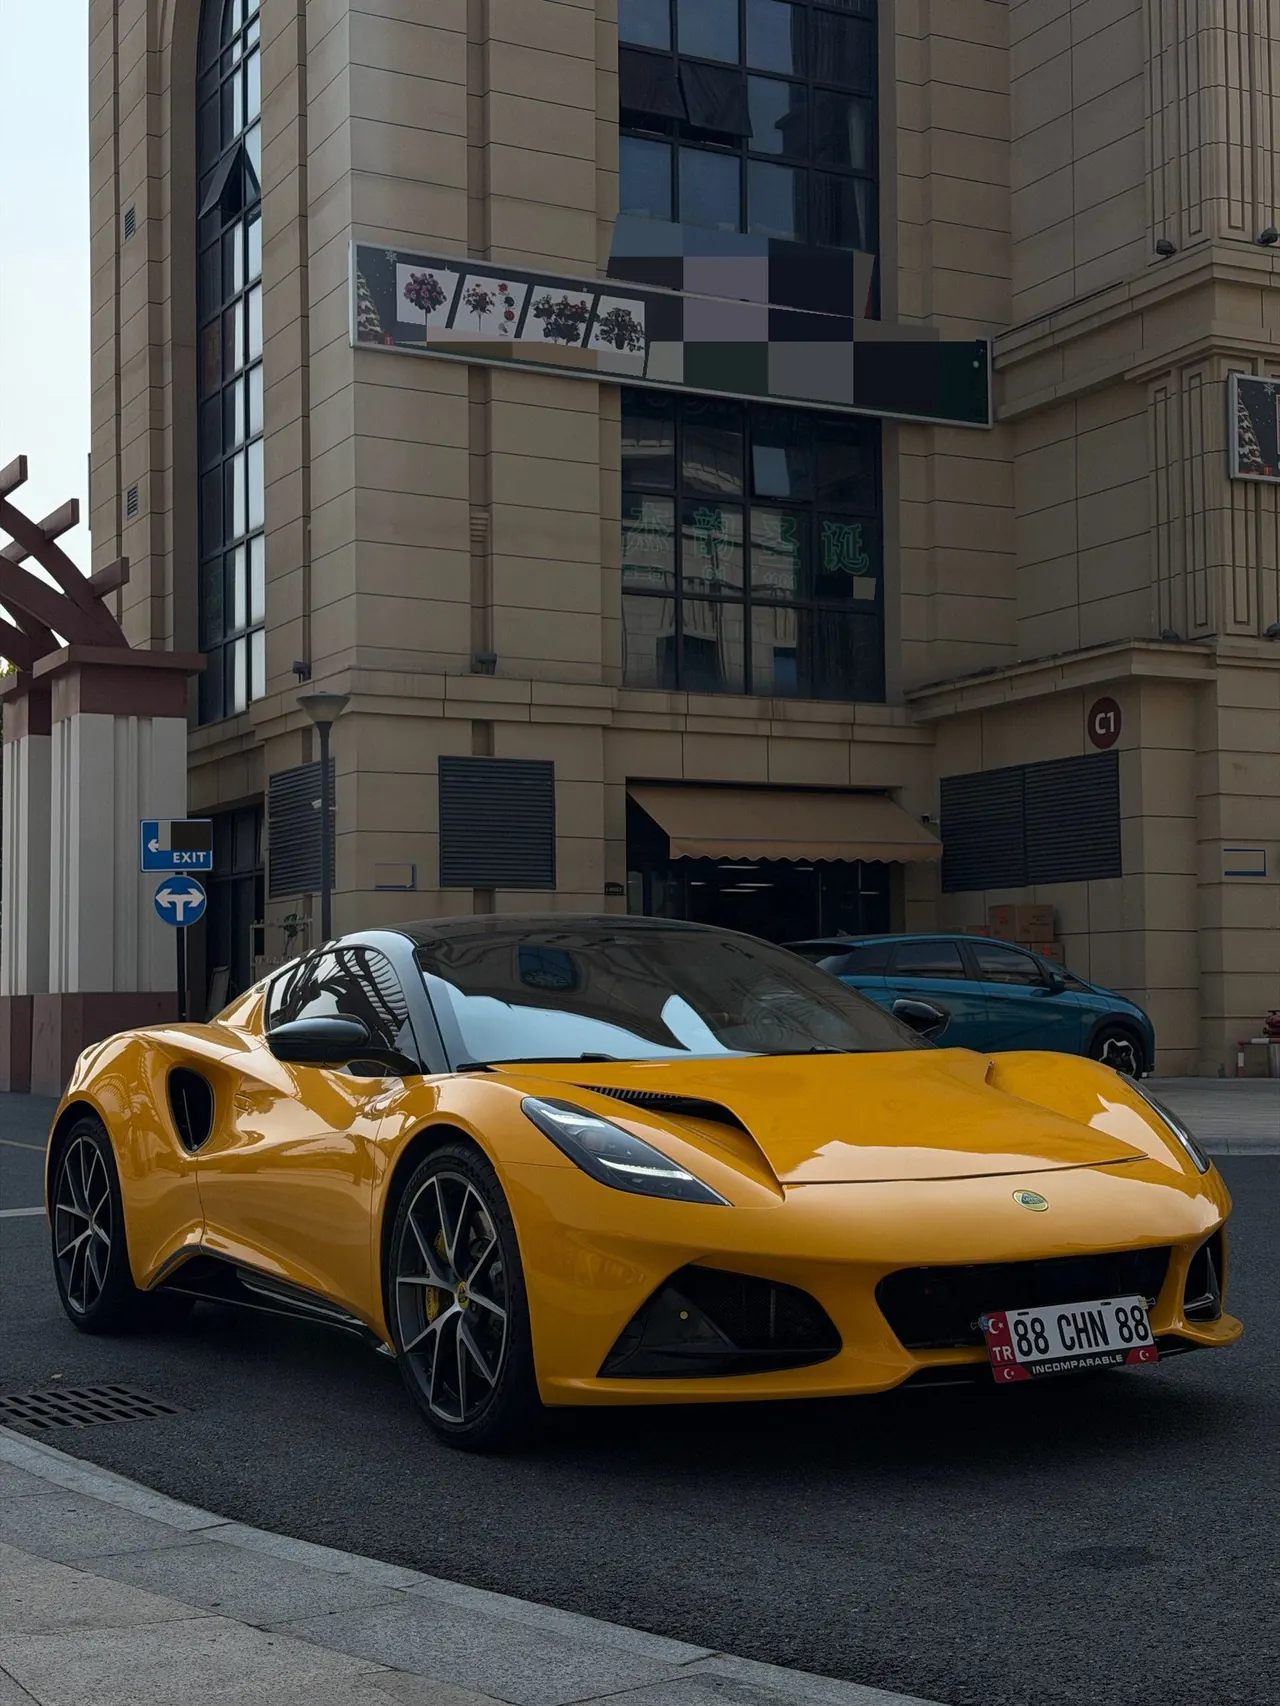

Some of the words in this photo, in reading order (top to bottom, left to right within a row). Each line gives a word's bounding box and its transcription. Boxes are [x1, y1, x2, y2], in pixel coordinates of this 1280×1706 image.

[1095, 711, 1115, 735] C1
[172, 851, 207, 864] EXIT
[1013, 1316, 1051, 1357] 88
[1056, 1310, 1110, 1351] CHN
[1114, 1305, 1149, 1344] 88
[992, 1346, 1014, 1361] TR
[1032, 1353, 1124, 1375] INCOMPARABLE
